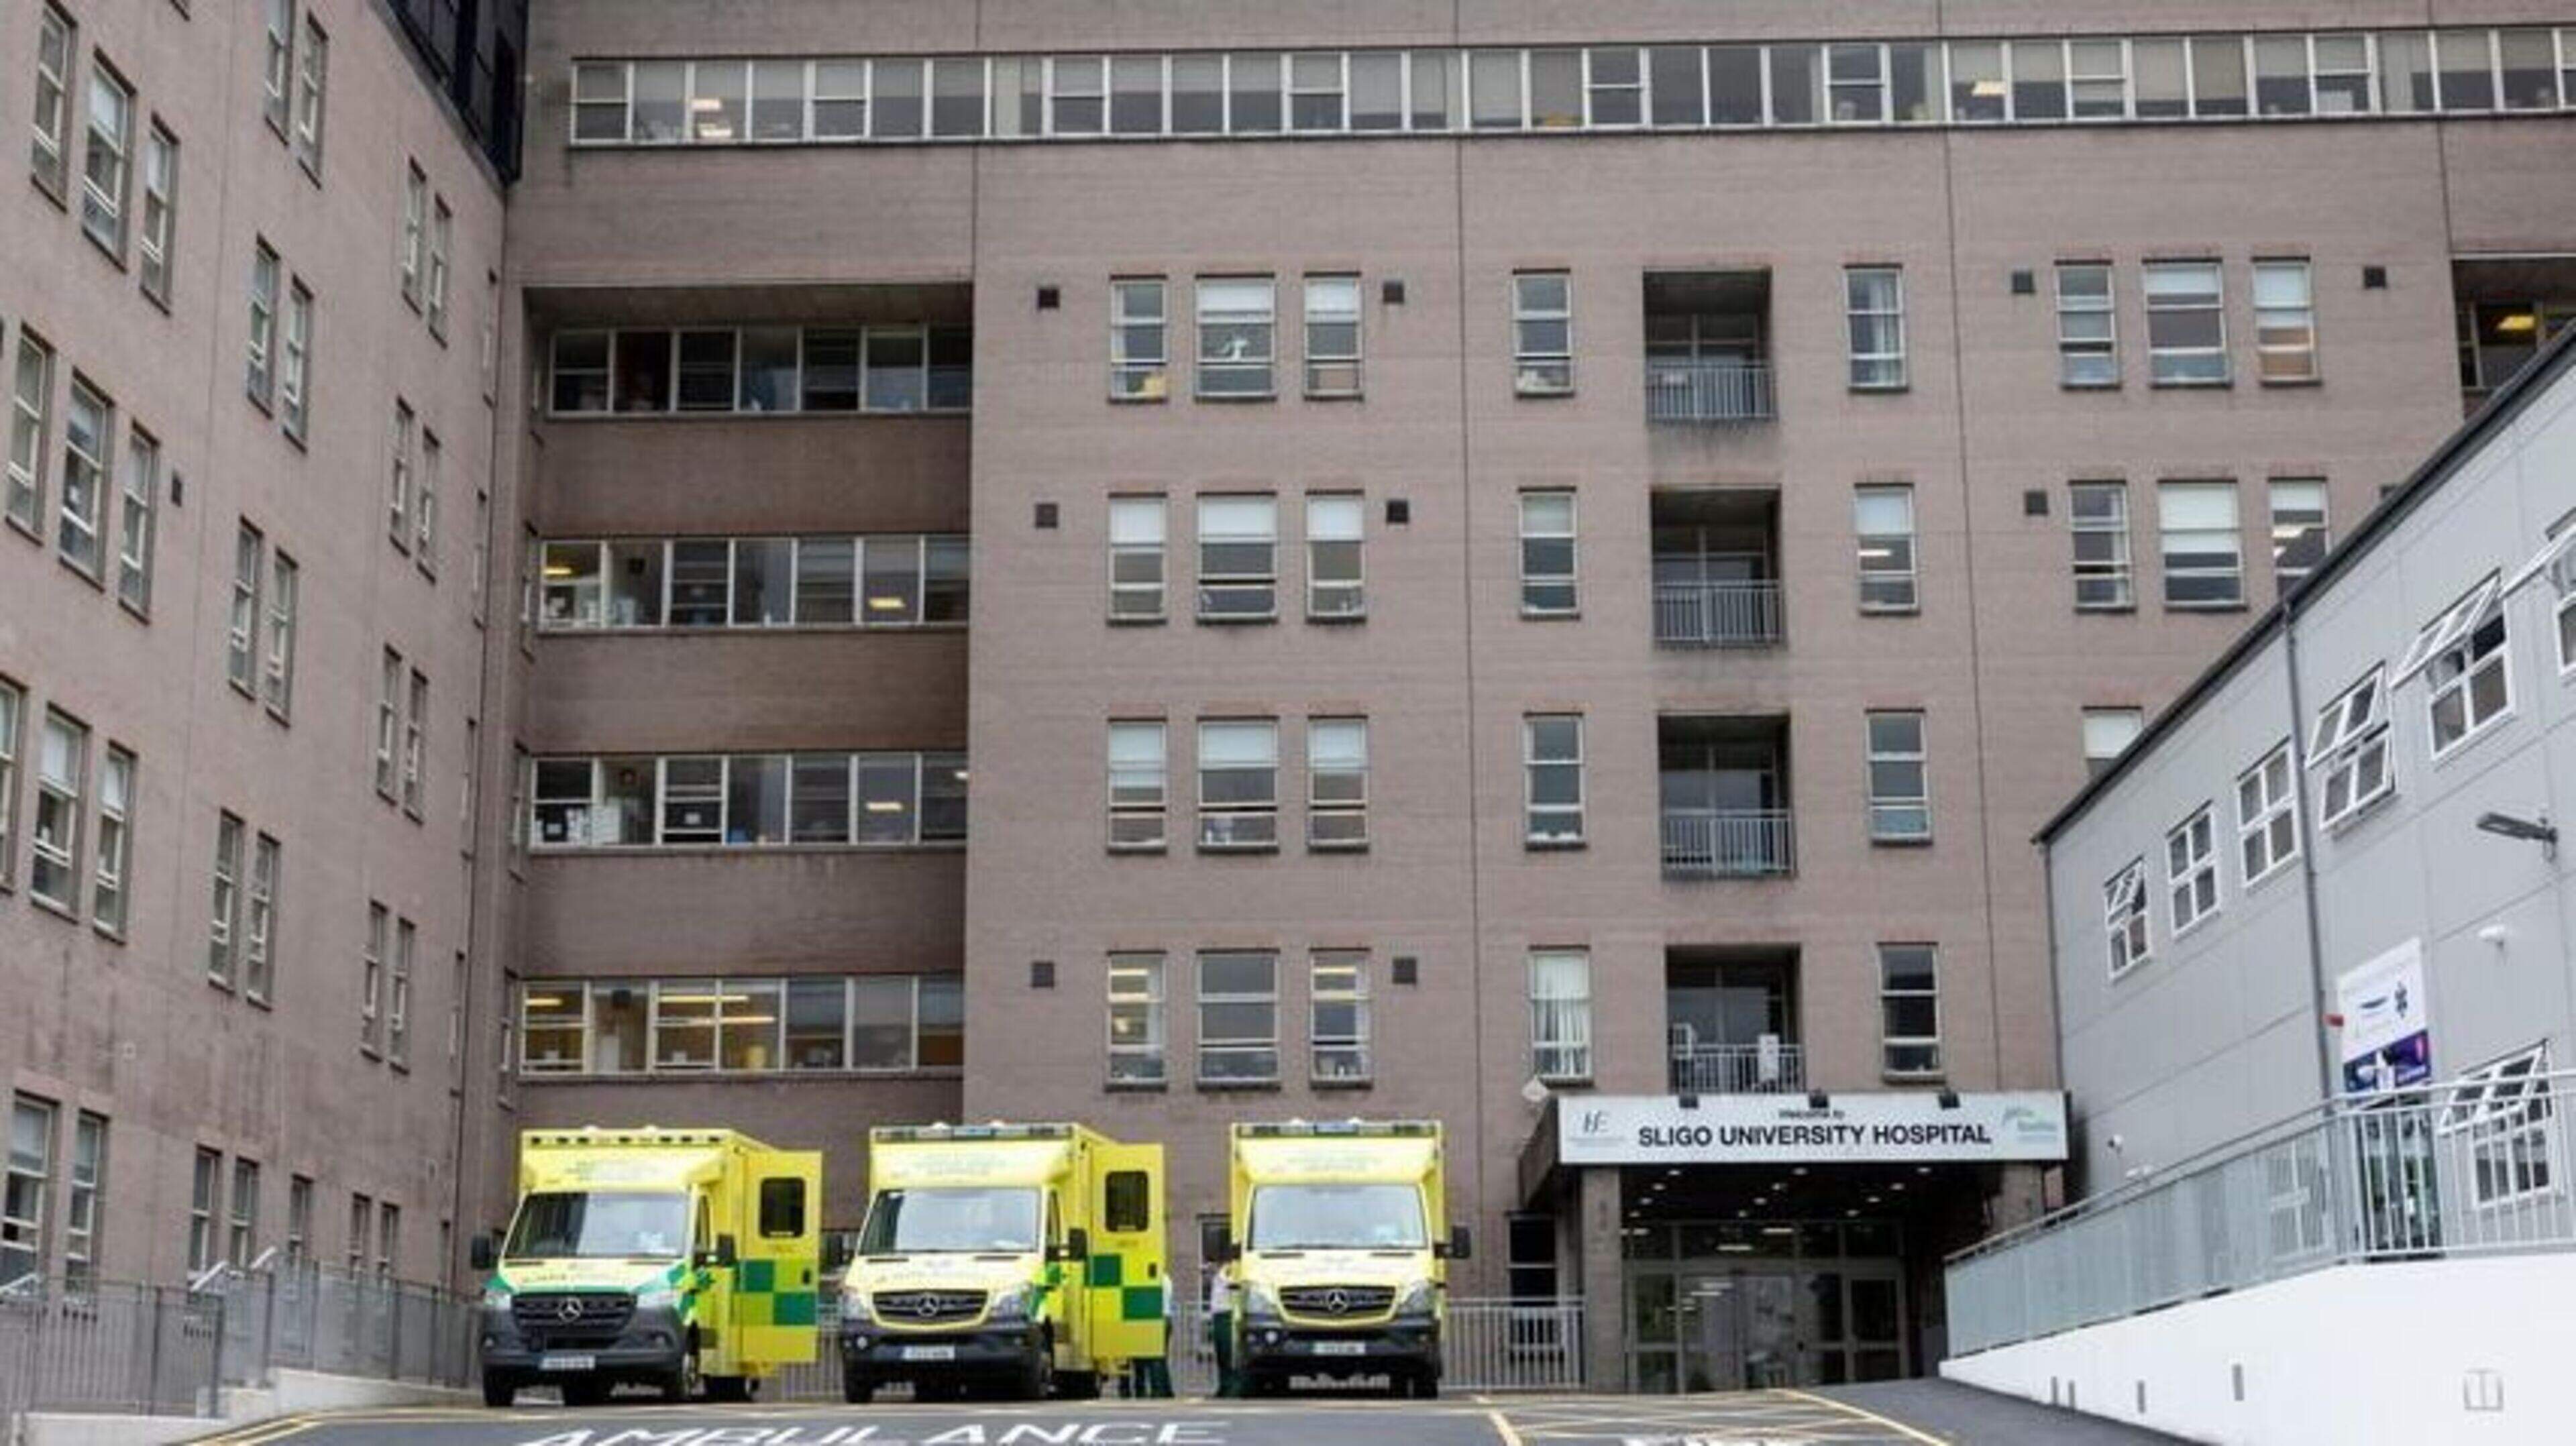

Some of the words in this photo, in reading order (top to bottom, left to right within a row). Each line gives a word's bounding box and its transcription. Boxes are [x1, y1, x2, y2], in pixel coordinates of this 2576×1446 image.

[1638, 1125, 1713, 1147] SLIGO
[1719, 1125, 1865, 1146] UNIVERSITY
[1872, 1124, 1992, 1145] HOSPITAL
[515, 1421, 1229, 1446] AMBULANCE
